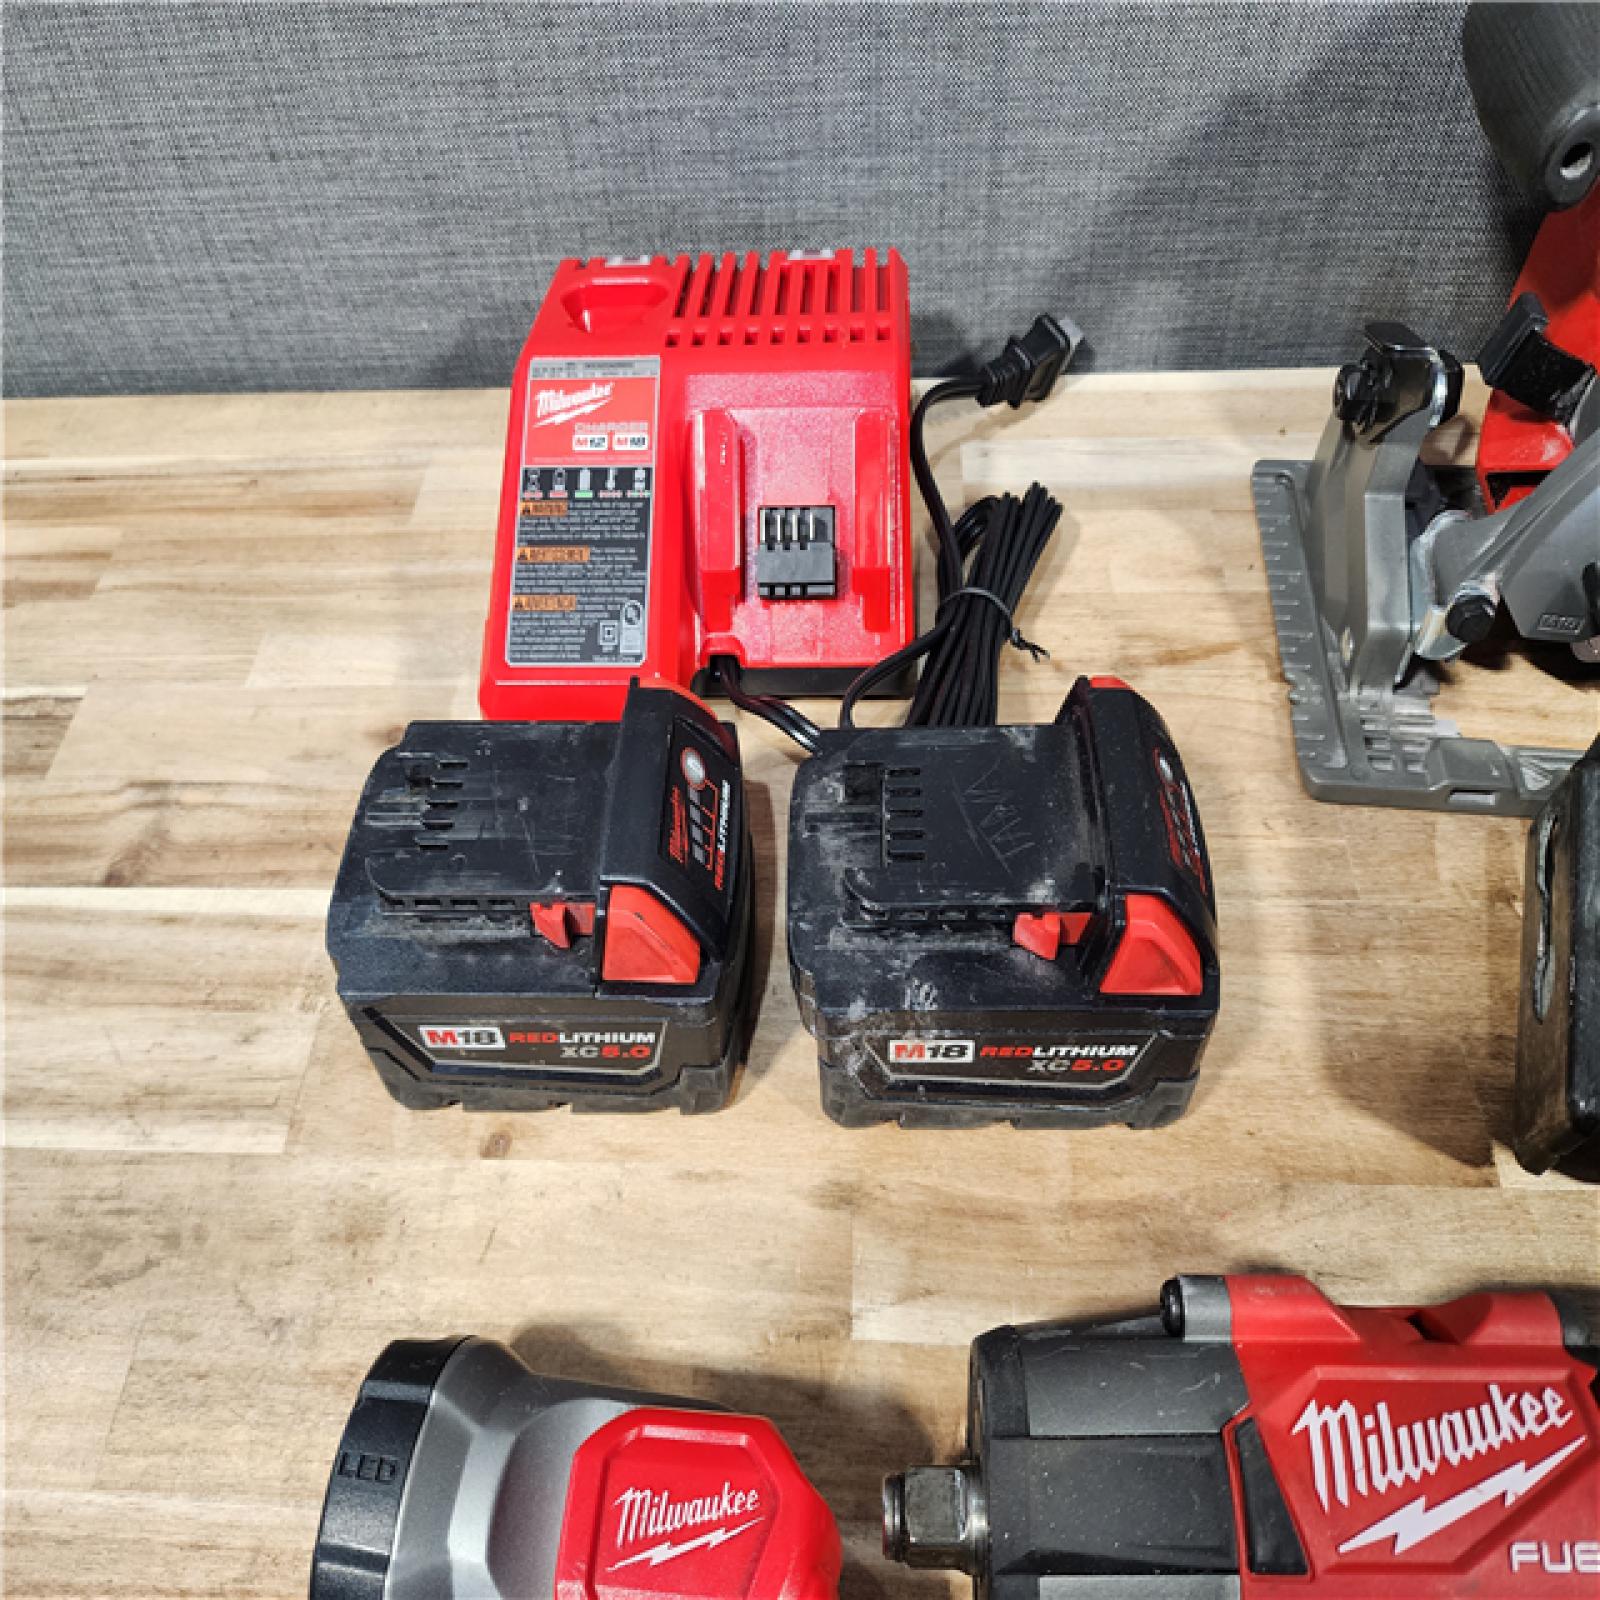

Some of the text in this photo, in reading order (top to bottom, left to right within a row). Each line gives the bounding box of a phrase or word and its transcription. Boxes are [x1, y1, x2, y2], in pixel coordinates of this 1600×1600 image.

[425, 1028, 656, 1046] M18 REDLITHIUM
[893, 1043, 1138, 1060] M18 REDLITHIUM
[1027, 1058, 1127, 1072] XC5.0
[1291, 1382, 1575, 1514] Milwaukee
[336, 1451, 399, 1483] LED
[614, 1480, 761, 1549] Milwaukee
[1509, 1540, 1600, 1574] FUE
